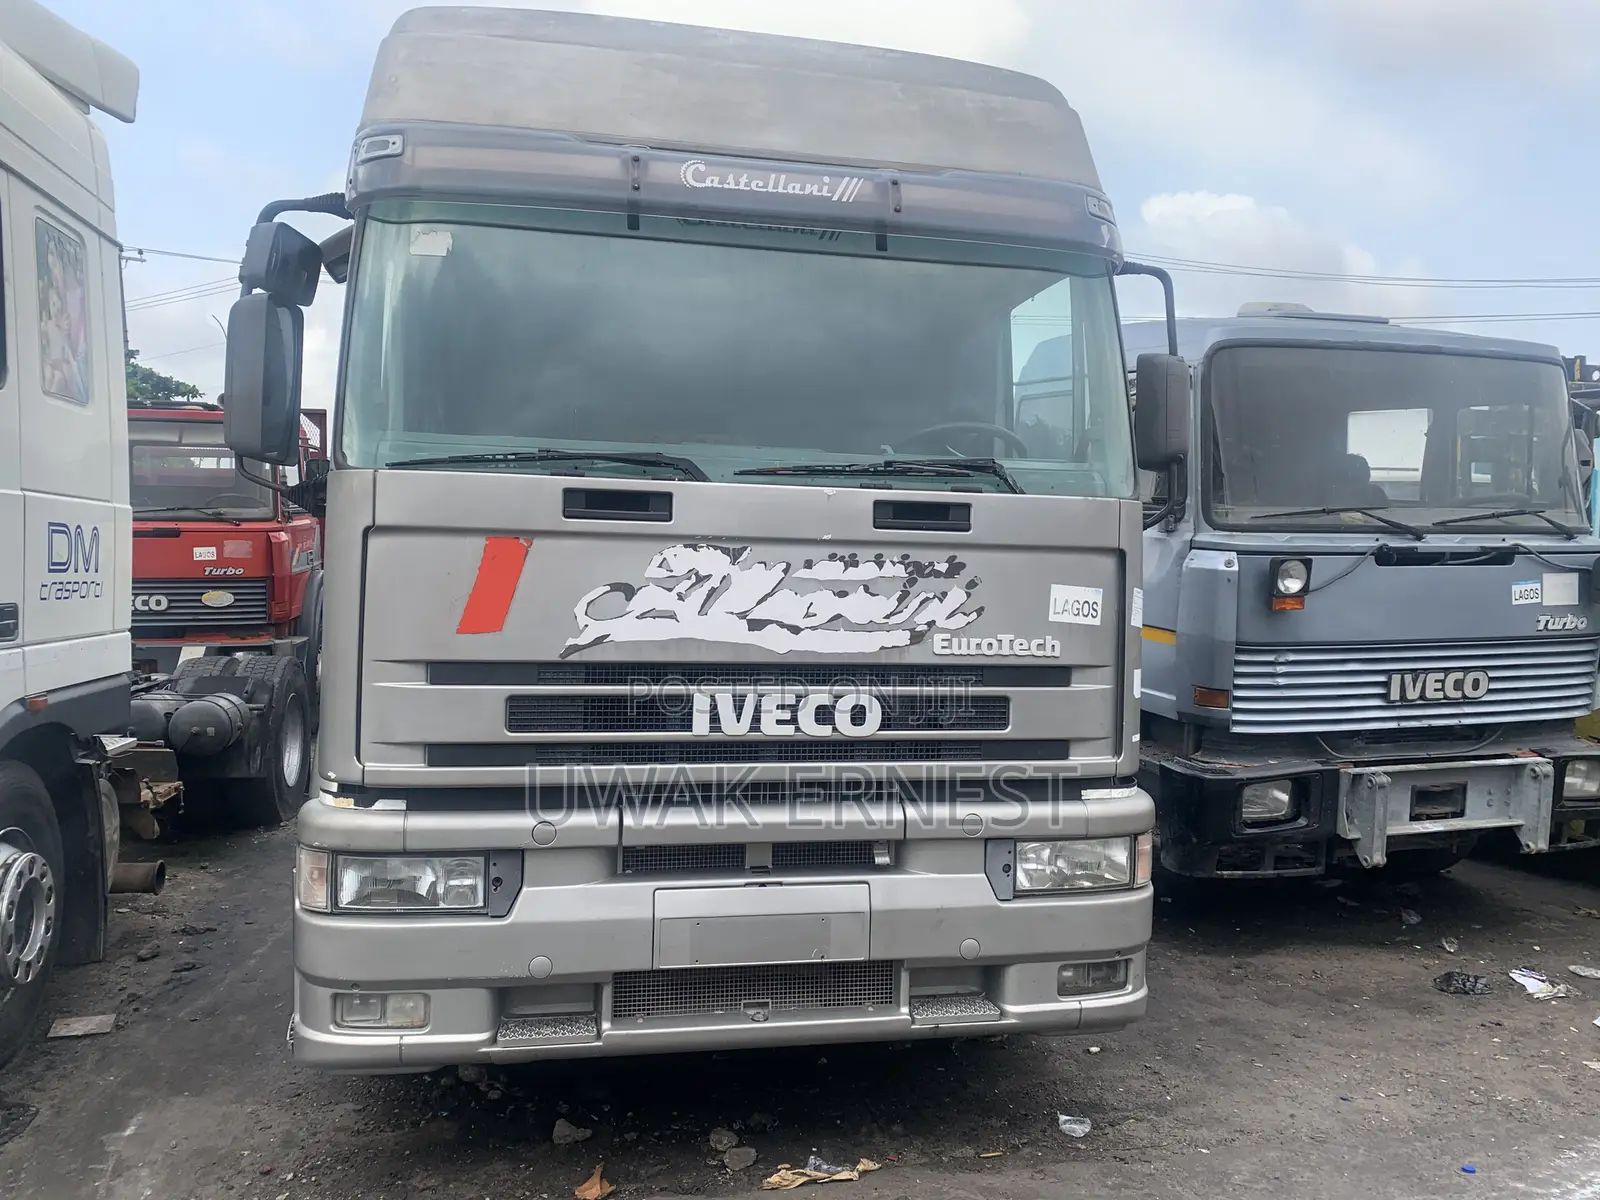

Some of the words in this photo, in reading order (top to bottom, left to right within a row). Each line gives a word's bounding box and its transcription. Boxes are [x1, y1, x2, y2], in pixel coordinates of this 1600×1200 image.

[680, 159, 832, 197] Castellani
[47, 521, 100, 573] DM
[203, 566, 245, 576] Turbo
[40, 581, 103, 600] trasporti
[1513, 588, 1540, 601] LAGOS
[1052, 597, 1099, 619] LAGOS
[1537, 613, 1588, 631] Turbo
[932, 633, 1061, 658] EuroTech
[1388, 670, 1490, 702] IVECO
[692, 692, 882, 737] IVECO
